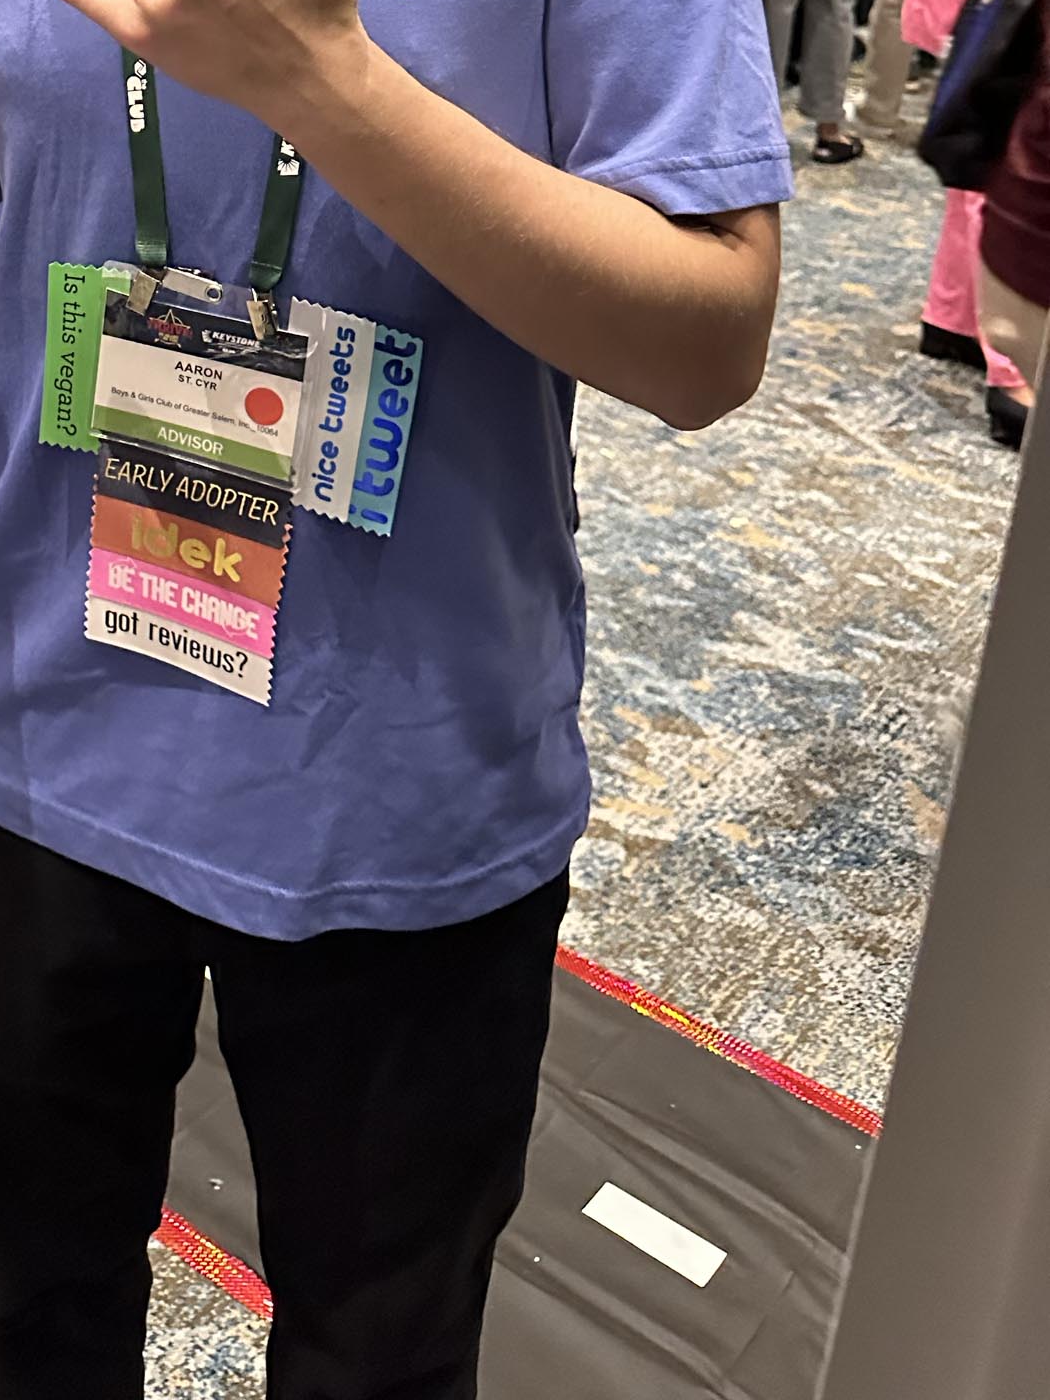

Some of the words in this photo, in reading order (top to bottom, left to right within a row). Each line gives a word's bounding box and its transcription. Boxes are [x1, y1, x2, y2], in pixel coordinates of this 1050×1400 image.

[127, 76, 145, 132] CLUB
[64, 273, 86, 294] Is
[62, 301, 86, 345] this
[54, 351, 77, 436] vegan?
[175, 360, 223, 380] AARON
[178, 374, 193, 385] ST.
[195, 378, 218, 391] CYR
[318, 326, 356, 433] tweets
[111, 386, 129, 398] Boys
[138, 392, 154, 404] Girls
[156, 396, 173, 408] Club
[174, 402, 182, 410] of
[182, 404, 210, 418] Greater
[353, 334, 417, 497] tweet
[157, 426, 224, 456] ADVISOR
[105, 458, 174, 493] EARLY
[175, 476, 279, 526] ADOPTER
[311, 440, 339, 502] nice
[348, 504, 388, 524] i
[131, 510, 243, 582] idek
[108, 563, 137, 594] BE
[139, 571, 179, 609] THE
[181, 586, 260, 640] CHANGE
[105, 609, 139, 636] got
[149, 621, 249, 678] reviews?
